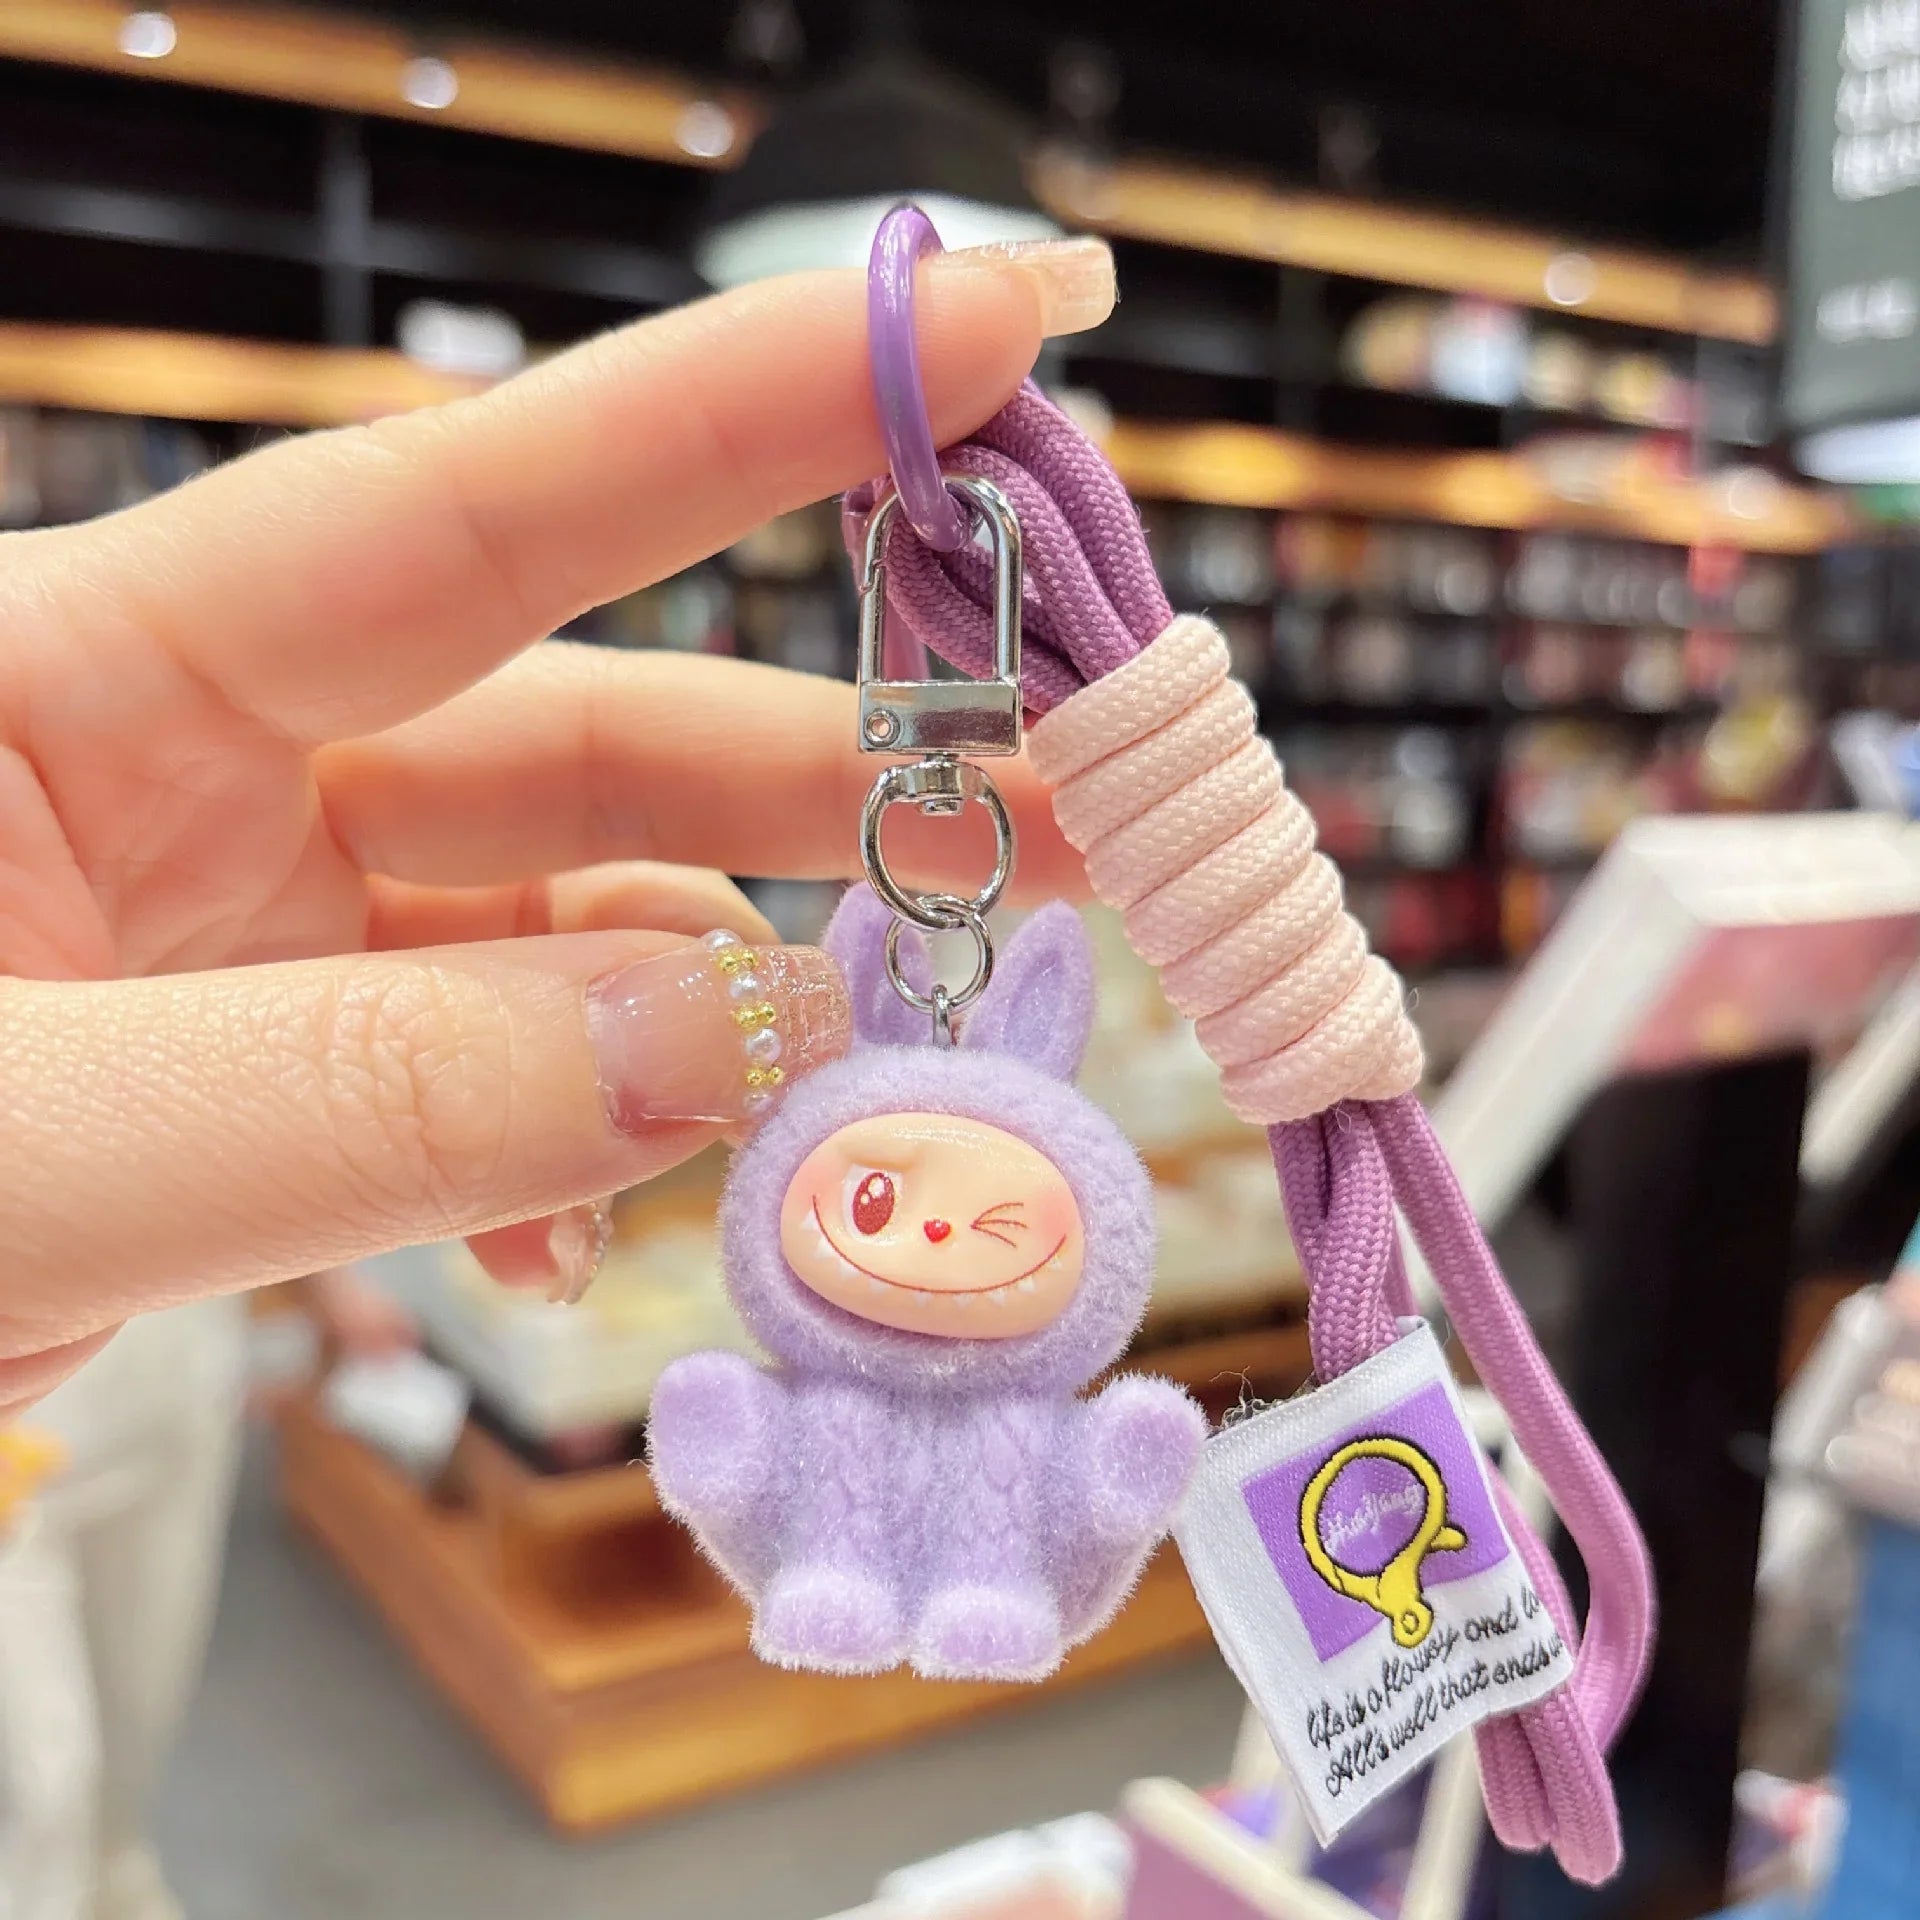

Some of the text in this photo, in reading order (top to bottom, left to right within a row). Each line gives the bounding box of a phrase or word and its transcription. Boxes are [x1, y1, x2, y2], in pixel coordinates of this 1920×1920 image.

[1465, 1596, 1518, 1642] and
[1390, 1685, 1438, 1750] well
[1439, 1658, 1489, 1711] that
[1492, 1640, 1550, 1685] ends
